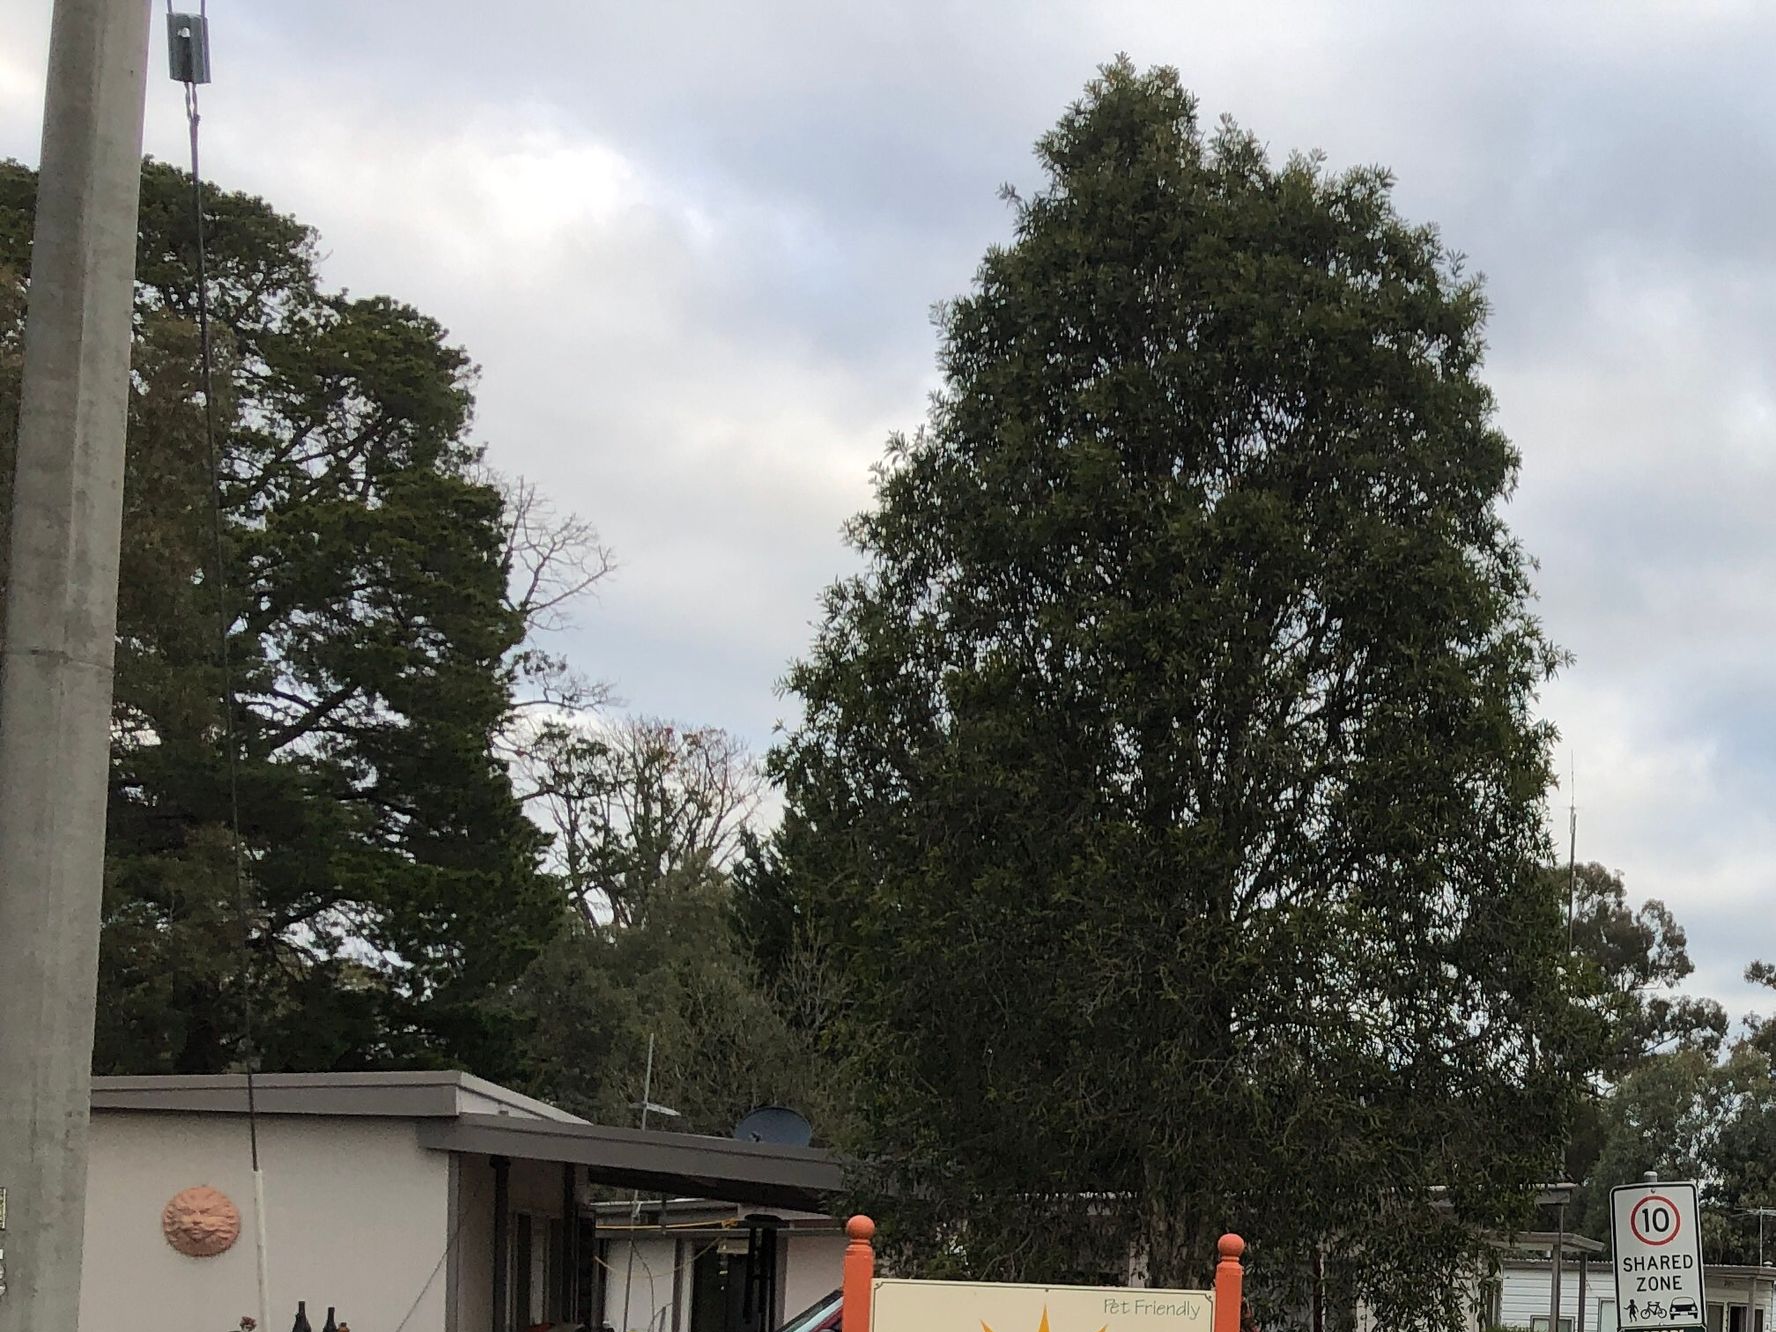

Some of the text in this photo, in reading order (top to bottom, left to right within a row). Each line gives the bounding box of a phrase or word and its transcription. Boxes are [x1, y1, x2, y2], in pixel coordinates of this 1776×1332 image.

[1641, 1207, 1670, 1233] 10
[1623, 1254, 1693, 1272] SHARED
[1636, 1275, 1683, 1292] ZONE
[1103, 1298, 1201, 1320] Pet Friendly
